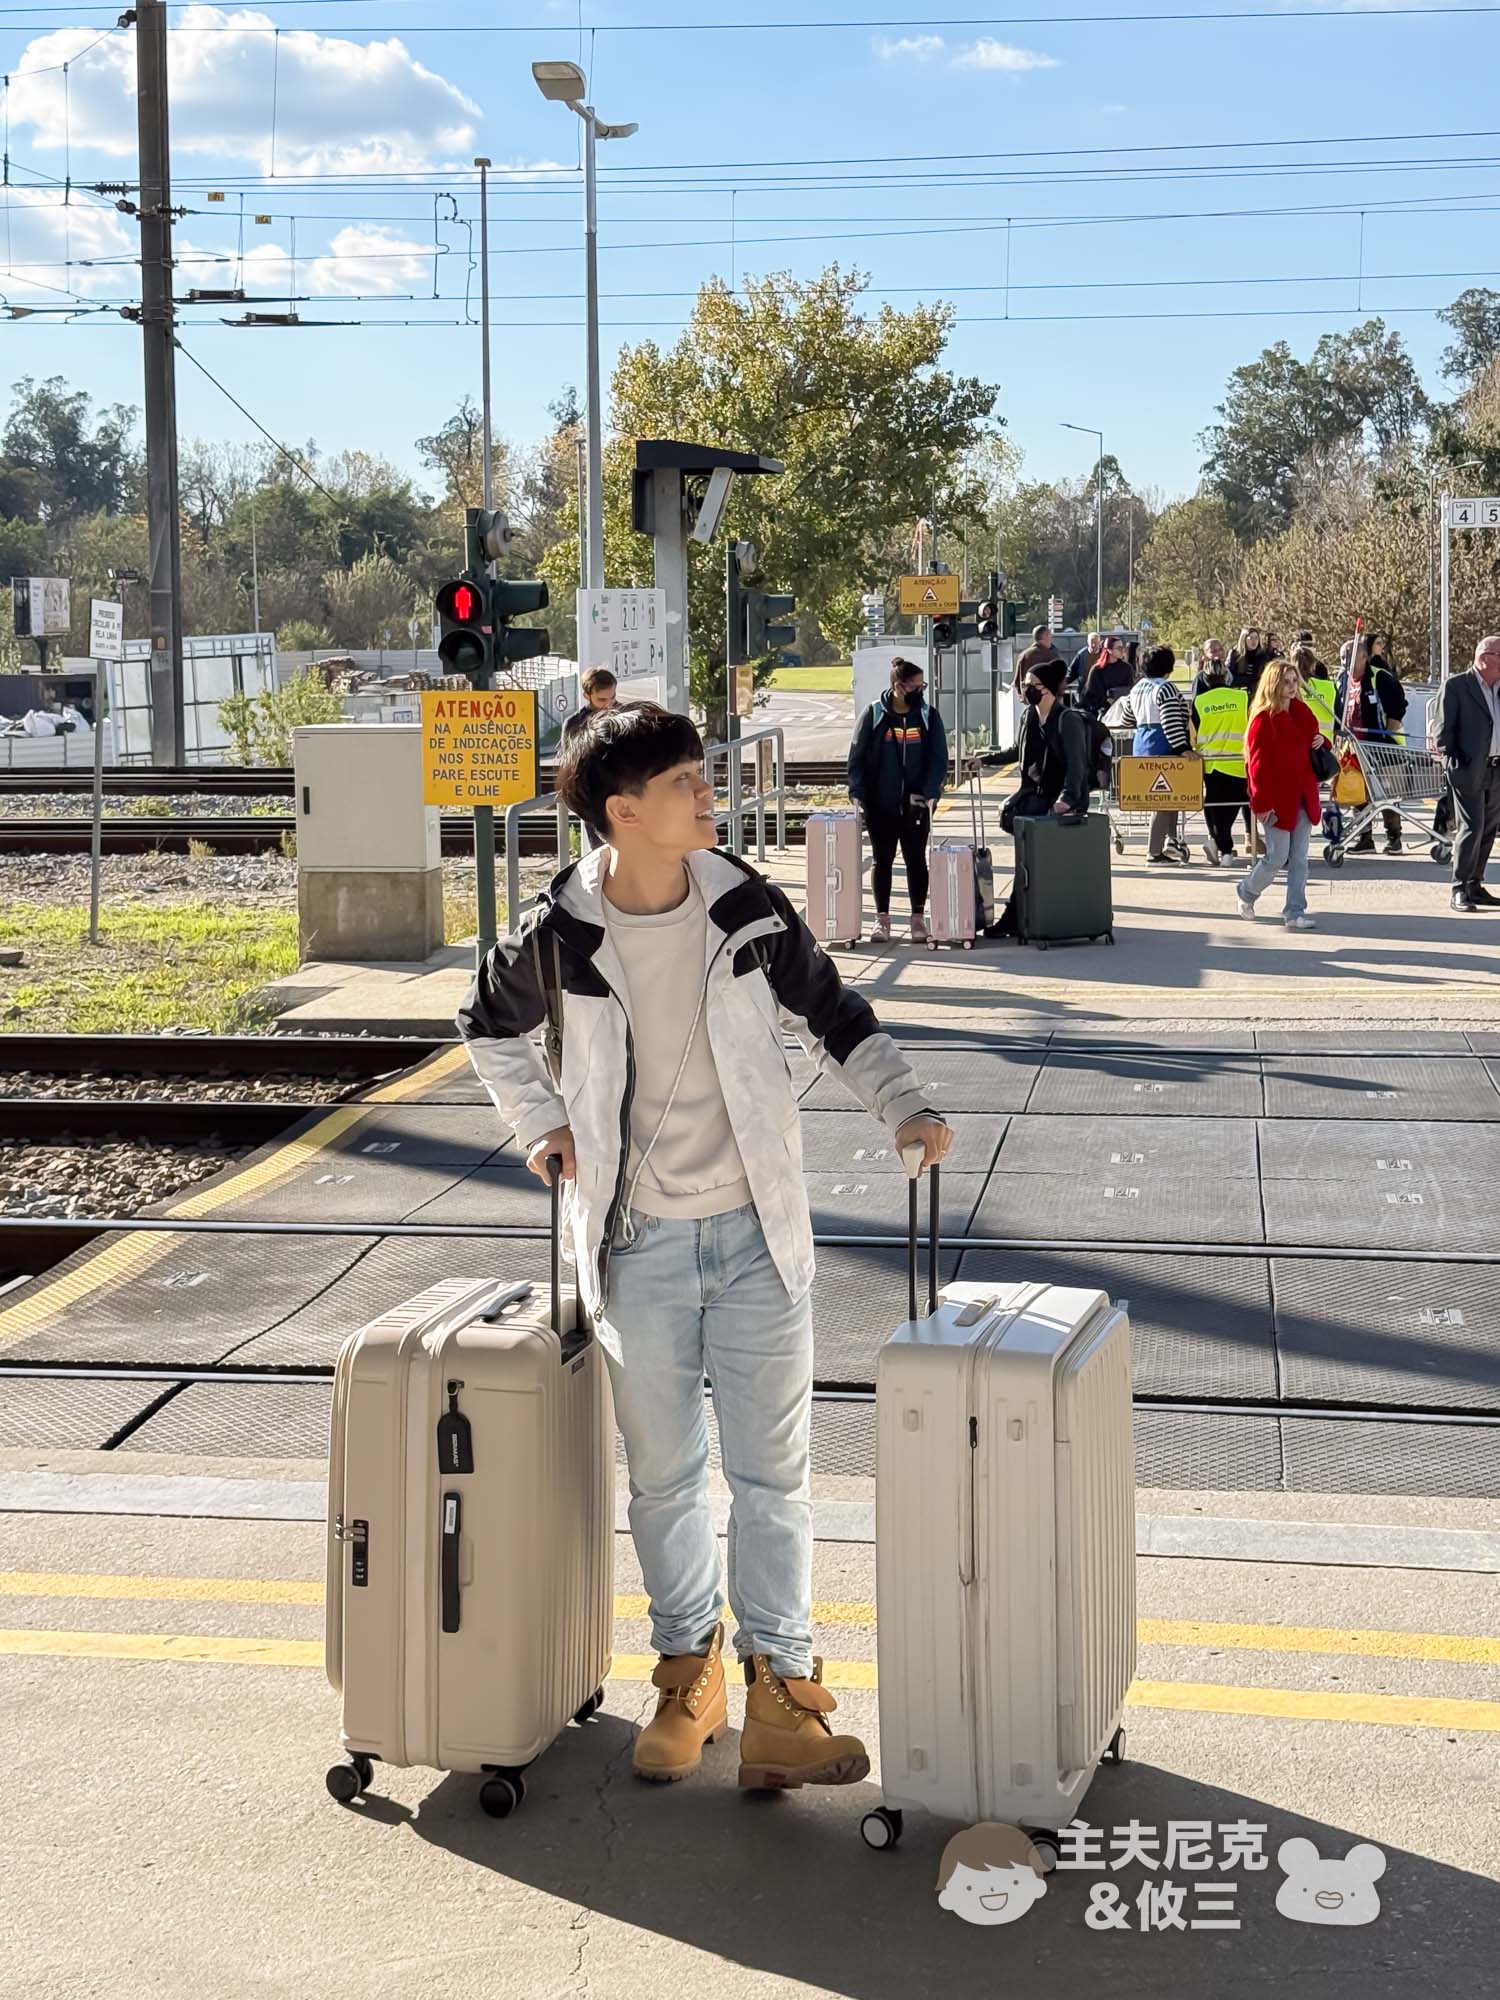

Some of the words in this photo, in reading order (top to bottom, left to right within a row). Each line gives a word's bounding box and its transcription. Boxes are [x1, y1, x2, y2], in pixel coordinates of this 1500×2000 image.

[1459, 510, 1469, 523] 4
[1489, 509, 1498, 522] 5
[434, 694, 517, 721] ATENÇÃO
[434, 723, 451, 735] NA
[462, 719, 527, 735] AUSÊNCIA
[429, 738, 445, 750] DE
[453, 735, 532, 753] INDICAÇÕES
[439, 753, 464, 765] NOS
[471, 753, 519, 765] SINAIS
[470, 769, 520, 781] ESCUTE
[455, 785, 463, 797] E
[467, 785, 501, 797] OLHE
